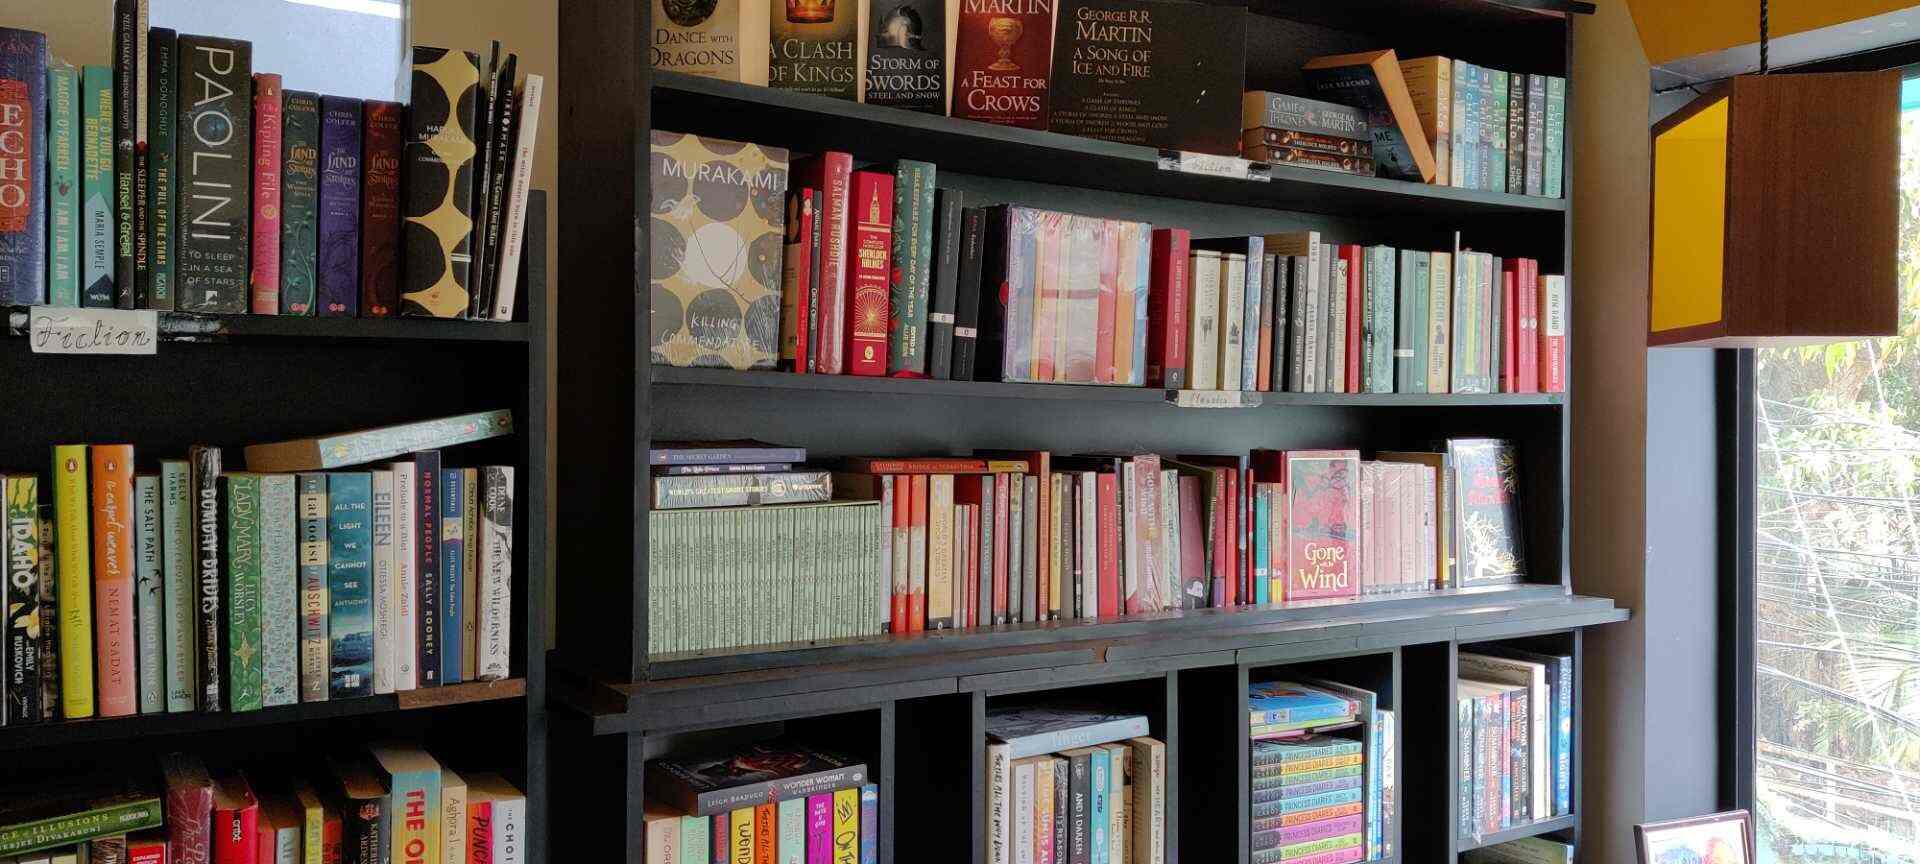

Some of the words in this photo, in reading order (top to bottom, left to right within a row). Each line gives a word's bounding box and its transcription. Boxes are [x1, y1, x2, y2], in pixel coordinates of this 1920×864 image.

[963, 0, 1050, 14] MARTIN
[1077, 7, 1128, 22] GEORGE
[122, 13, 130, 32] NEIL
[1075, 22, 1152, 43] MARTIN
[122, 33, 130, 65] GAIMAN
[656, 28, 706, 45] DANCE
[160, 47, 168, 74] EMMA
[651, 47, 736, 67] DRAGONS
[783, 40, 853, 60] CLASH
[871, 55, 921, 71] STORM
[925, 60, 940, 71] OF
[1073, 47, 1083, 59] A
[1087, 46, 1129, 62] SONG
[1132, 49, 1152, 62] OF
[769, 67, 787, 82] OF
[792, 62, 854, 83] KINGS
[865, 69, 941, 91] SWORDS
[960, 79, 969, 88] A
[972, 71, 1020, 89] FEAST
[1023, 78, 1046, 89] FOR
[1072, 60, 1093, 75] ICE
[1096, 64, 1120, 77] AND
[1122, 64, 1152, 78] FIRE
[160, 79, 168, 137] DONOGHUE
[897, 92, 914, 100] AND
[916, 92, 940, 100] SNOW
[967, 89, 1040, 112] CROWS
[1529, 102, 1537, 140] CHILD
[1547, 104, 1555, 143] CHILD
[86, 118, 98, 181] BERNADETTE
[191, 46, 235, 240] PAOLINI
[258, 113, 278, 166] Kipling
[1374, 131, 1392, 142] ME
[2, 104, 27, 209] ECHO
[158, 168, 168, 184] THE
[261, 172, 277, 199] File
[662, 158, 779, 192] MURAKAMI
[120, 173, 131, 210] Hansel
[158, 185, 168, 206] PULL
[831, 180, 842, 220] SALMAN
[94, 211, 105, 237] MARIA
[157, 209, 167, 219] OF
[157, 223, 167, 238] THE
[94, 240, 105, 270] SEMPLE
[156, 240, 166, 265] STARS
[204, 252, 235, 261] SLEEP
[829, 224, 840, 267] RUSHDIE
[203, 277, 236, 286] STARS
[214, 265, 233, 273] SEA
[909, 275, 916, 286] OF
[36, 316, 151, 350] Fiction
[691, 312, 737, 330] KILLING
[1552, 310, 1560, 330] RAND
[143, 486, 154, 505] THE
[169, 472, 177, 507] HARMS
[231, 482, 254, 519] LADY
[400, 473, 408, 510] Prelude
[423, 472, 433, 516] NORMAL
[488, 486, 498, 513] COOK
[334, 503, 350, 511] ALL
[352, 502, 367, 510] THE
[374, 492, 391, 546] EILEEN
[143, 508, 154, 534] SALT
[338, 522, 362, 530] LIGHT
[11, 518, 36, 590] IDAHO
[143, 537, 154, 563] PATH
[232, 520, 254, 568] MARY
[1304, 542, 1345, 565] Gone
[1299, 560, 1348, 592] Wind
[233, 571, 244, 626] WORSLEY
[246, 585, 256, 614] LUCY
[424, 573, 434, 606] SALLY
[108, 588, 119, 637] NEMAT
[489, 587, 503, 656] WILDERNESS
[424, 610, 434, 656] ROONEY
[25, 646, 34, 671] EMILY
[109, 641, 121, 686] SADAT
[1463, 727, 1471, 781] SUMMONER
[406, 789, 425, 831] THE
[993, 801, 1003, 818] THE
[1075, 792, 1084, 813] AND
[33, 814, 109, 836] ILLUSIONS
[1074, 819, 1084, 855] DARKEN
